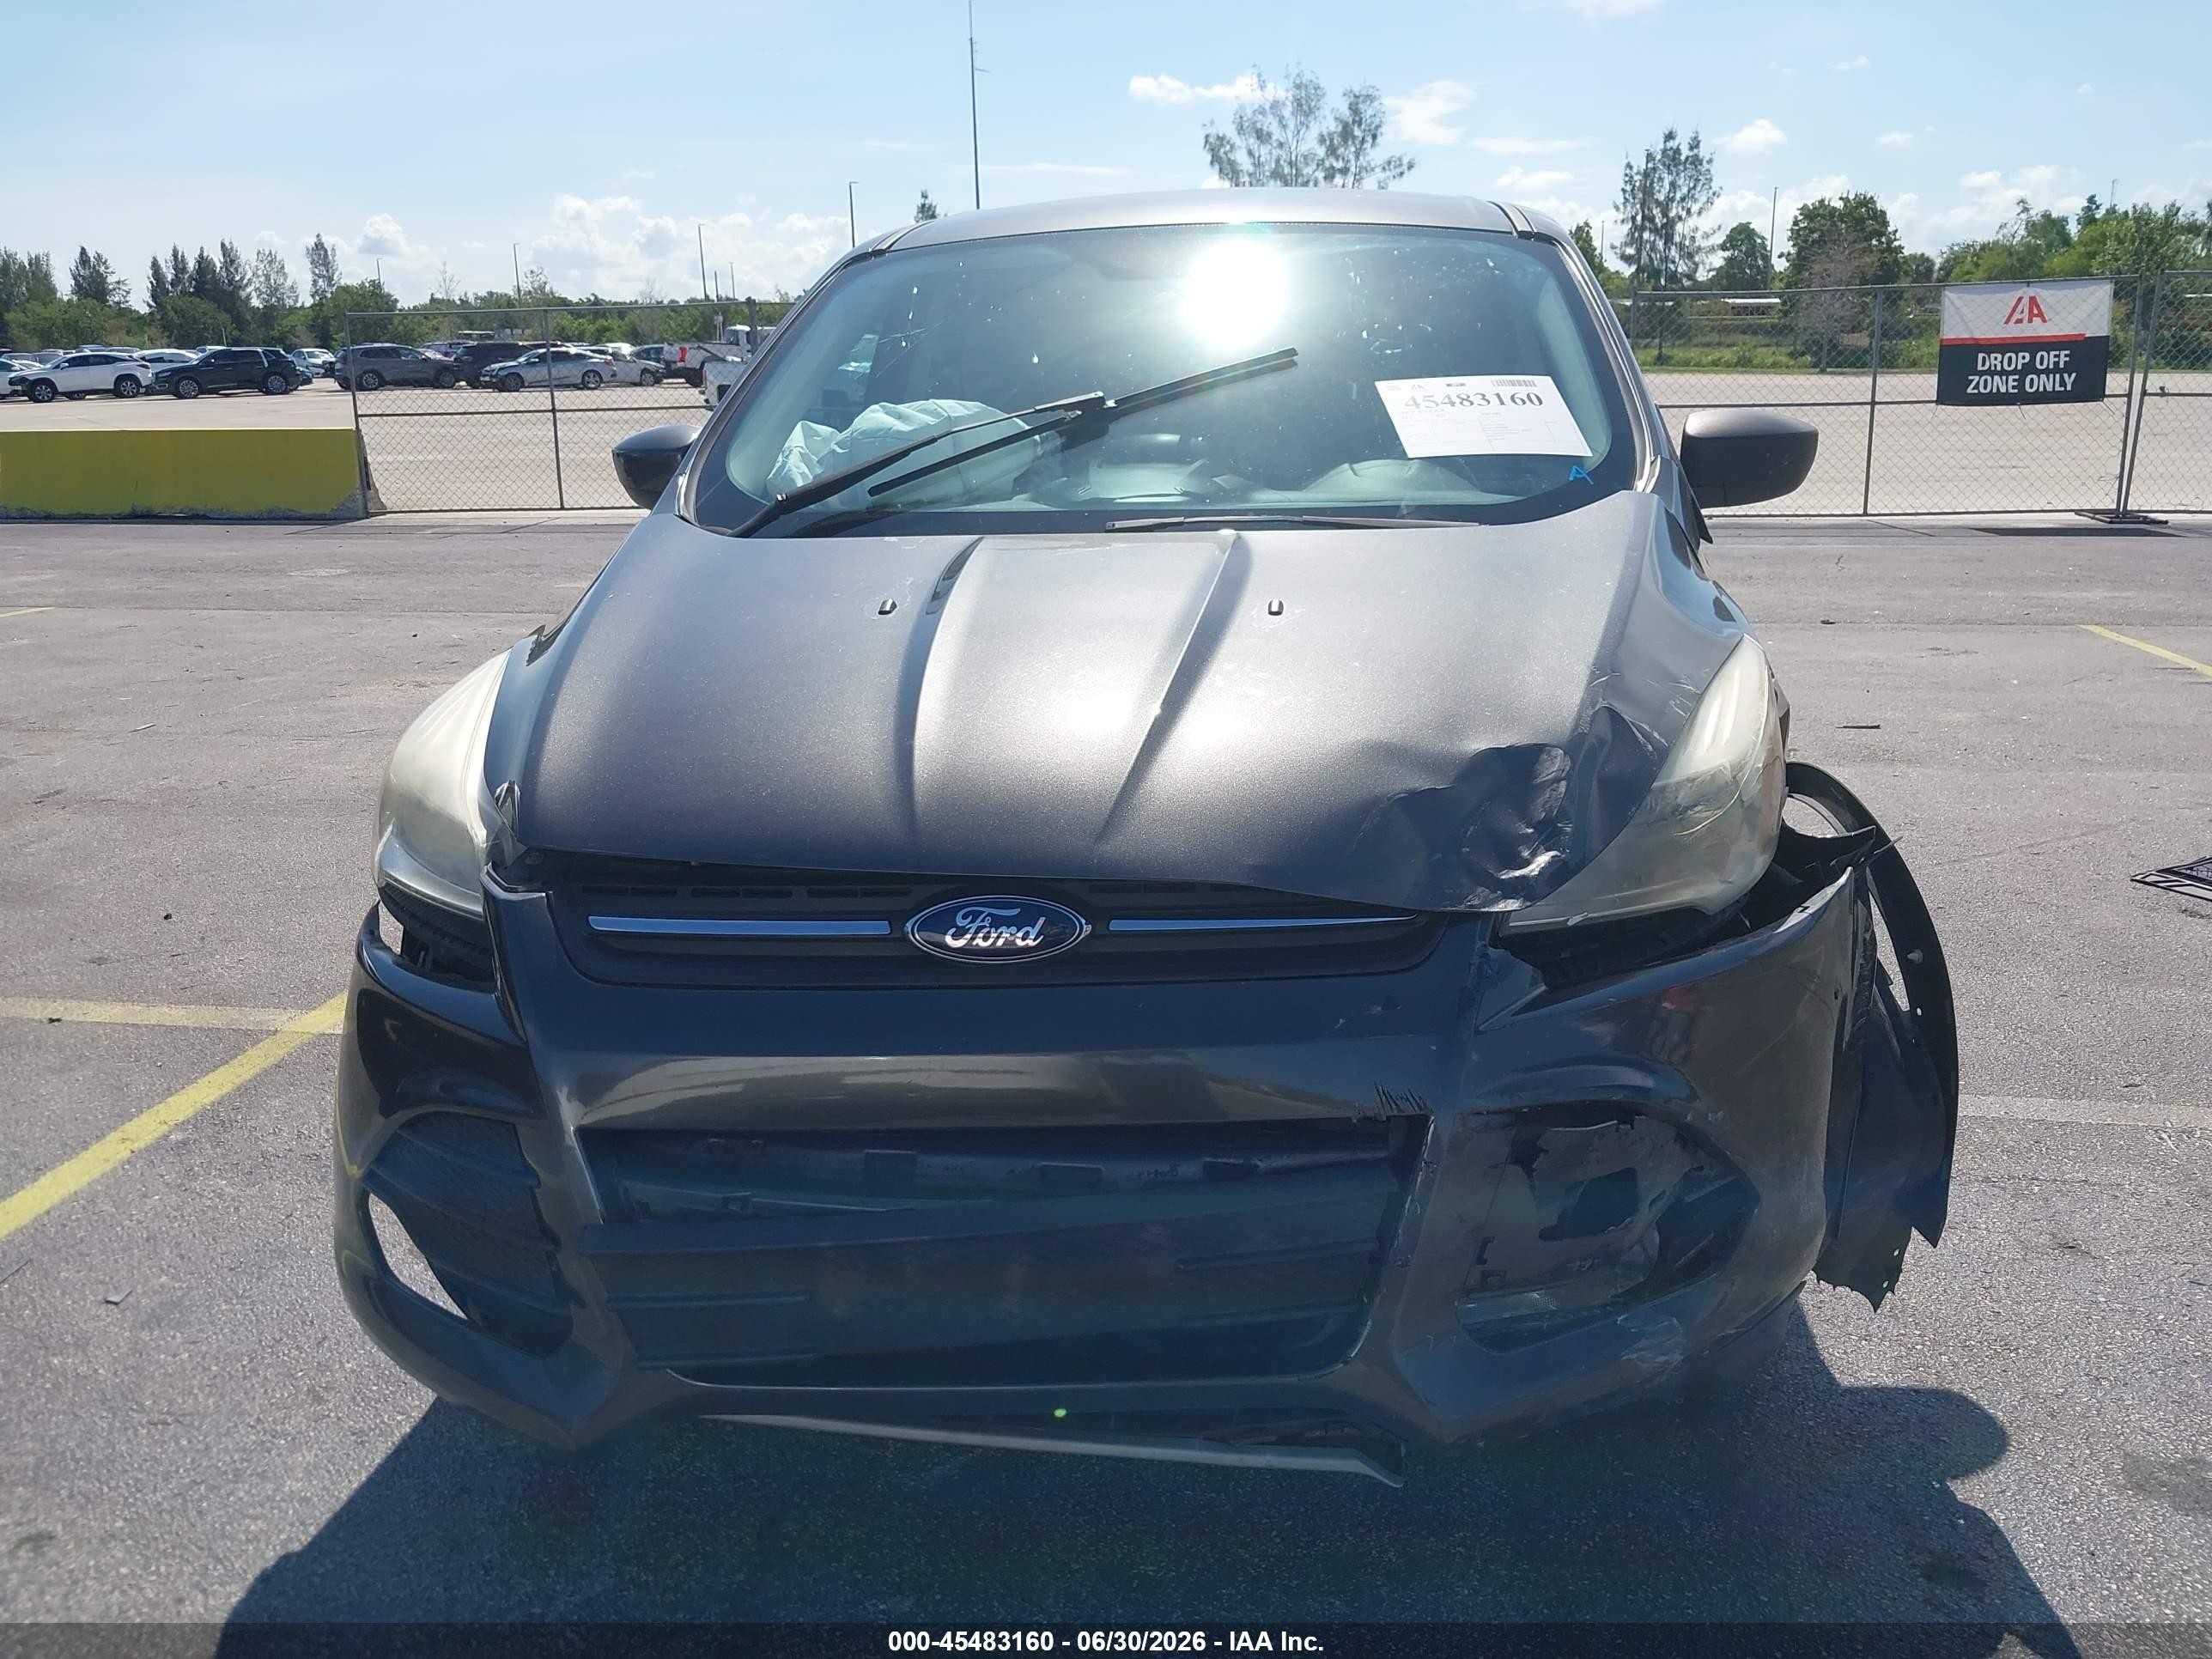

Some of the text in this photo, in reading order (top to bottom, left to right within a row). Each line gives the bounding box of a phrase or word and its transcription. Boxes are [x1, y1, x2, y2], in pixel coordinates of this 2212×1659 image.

[1977, 350, 2071, 371] DROP OFF
[1966, 373, 2076, 393] ZONE ONLY
[1405, 392, 1543, 409] 45483160
[945, 907, 1046, 947] Ford
